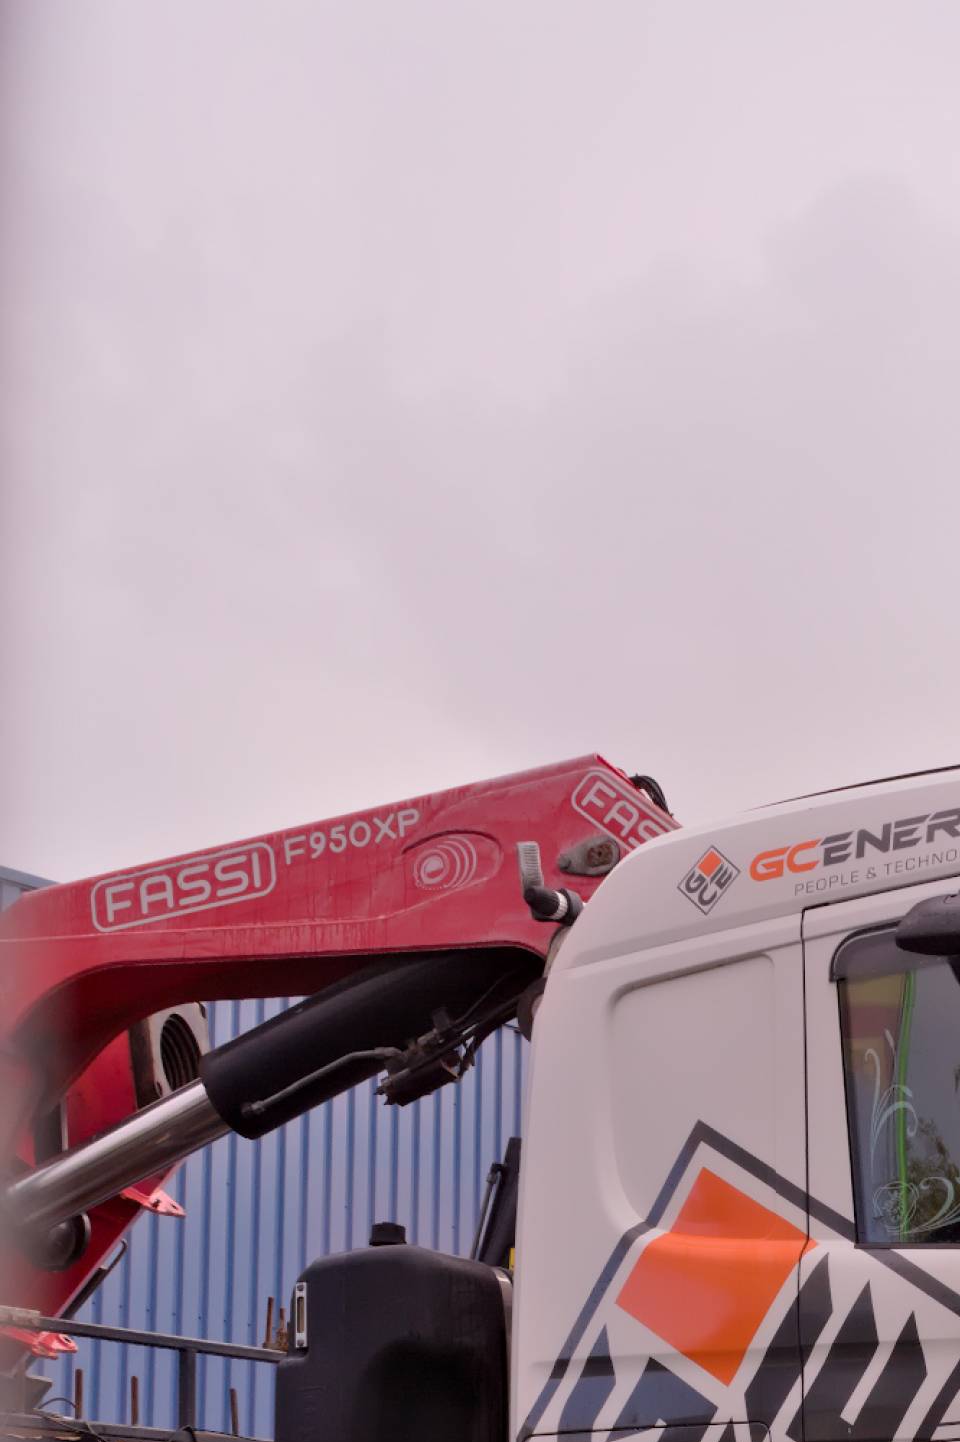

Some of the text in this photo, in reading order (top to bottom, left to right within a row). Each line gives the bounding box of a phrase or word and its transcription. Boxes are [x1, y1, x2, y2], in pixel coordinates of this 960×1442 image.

[581, 780, 664, 847] FAS
[105, 808, 420, 922] FASSI F950XP
[794, 871, 859, 896] PEOPLE
[864, 866, 877, 880] &
